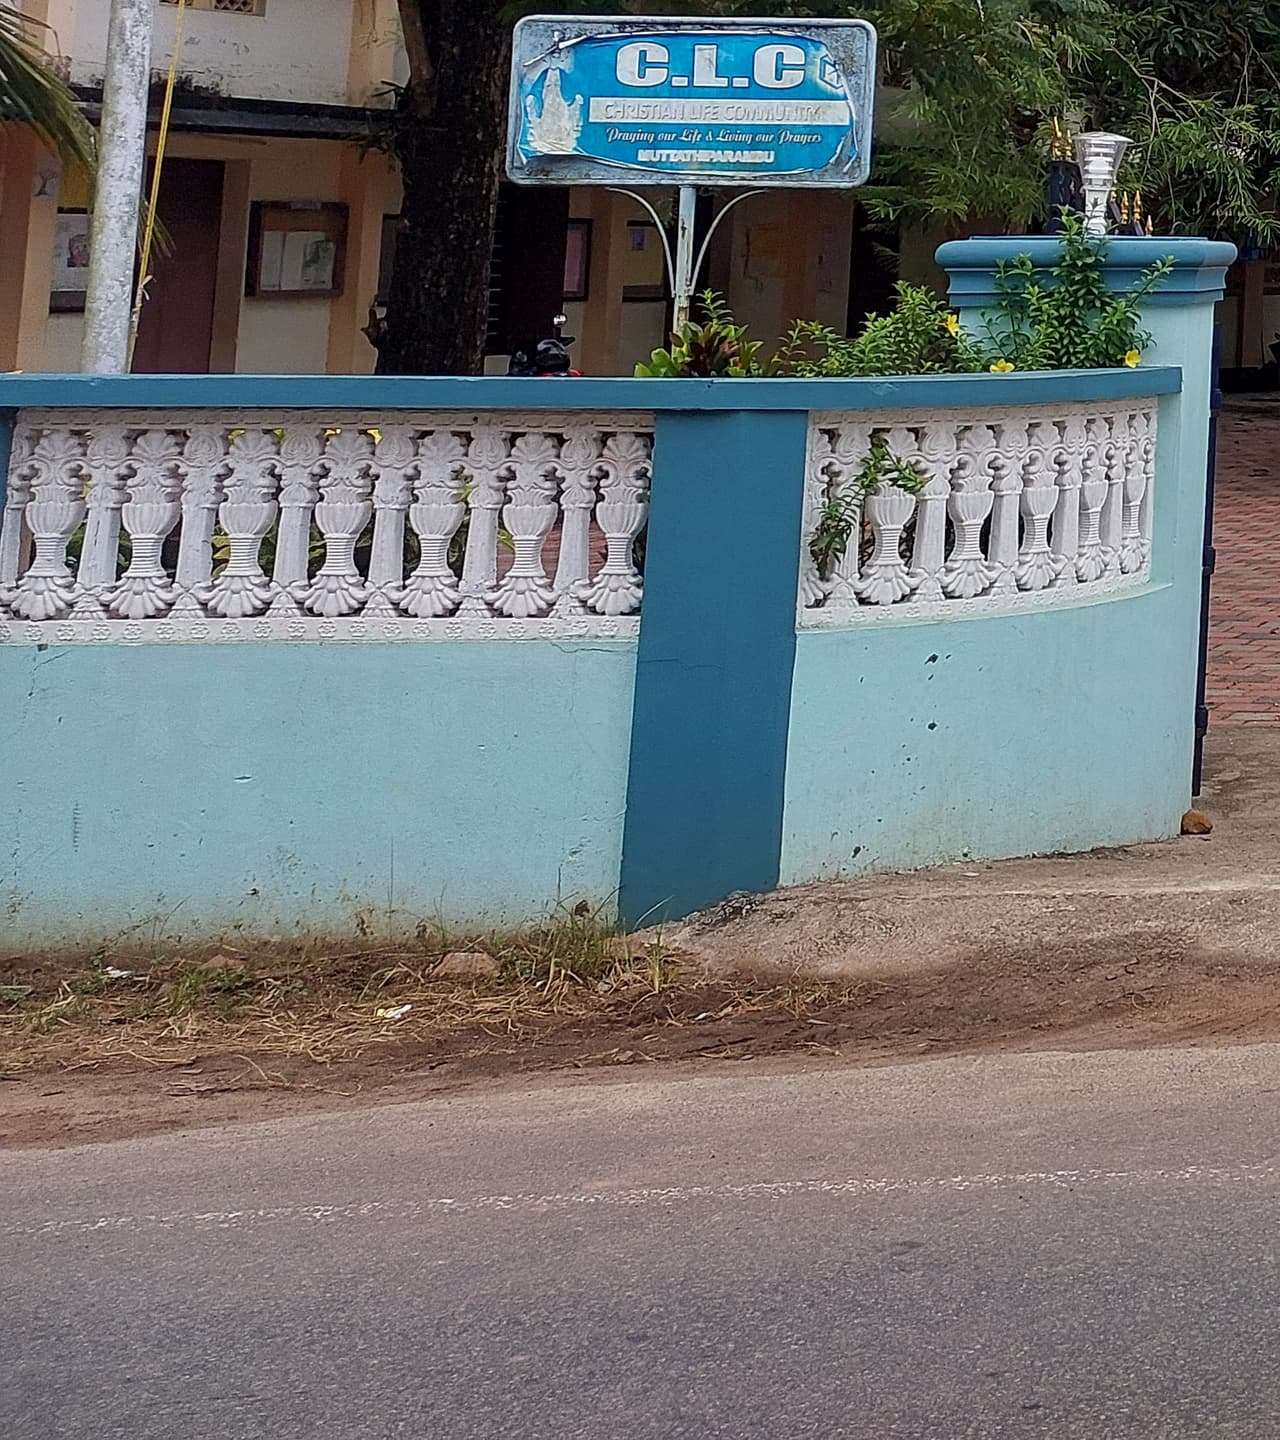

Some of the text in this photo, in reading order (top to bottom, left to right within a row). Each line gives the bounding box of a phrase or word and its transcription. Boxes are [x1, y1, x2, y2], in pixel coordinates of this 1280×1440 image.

[615, 42, 806, 89] C.L.C
[604, 102, 825, 121] CHRISTIAN LIFE COMMUNITY
[606, 127, 655, 144] Praying
[657, 131, 677, 141] our
[679, 128, 702, 144] Life
[716, 128, 753, 145] Living
[755, 132, 775, 142] our
[777, 128, 822, 145] Prayers
